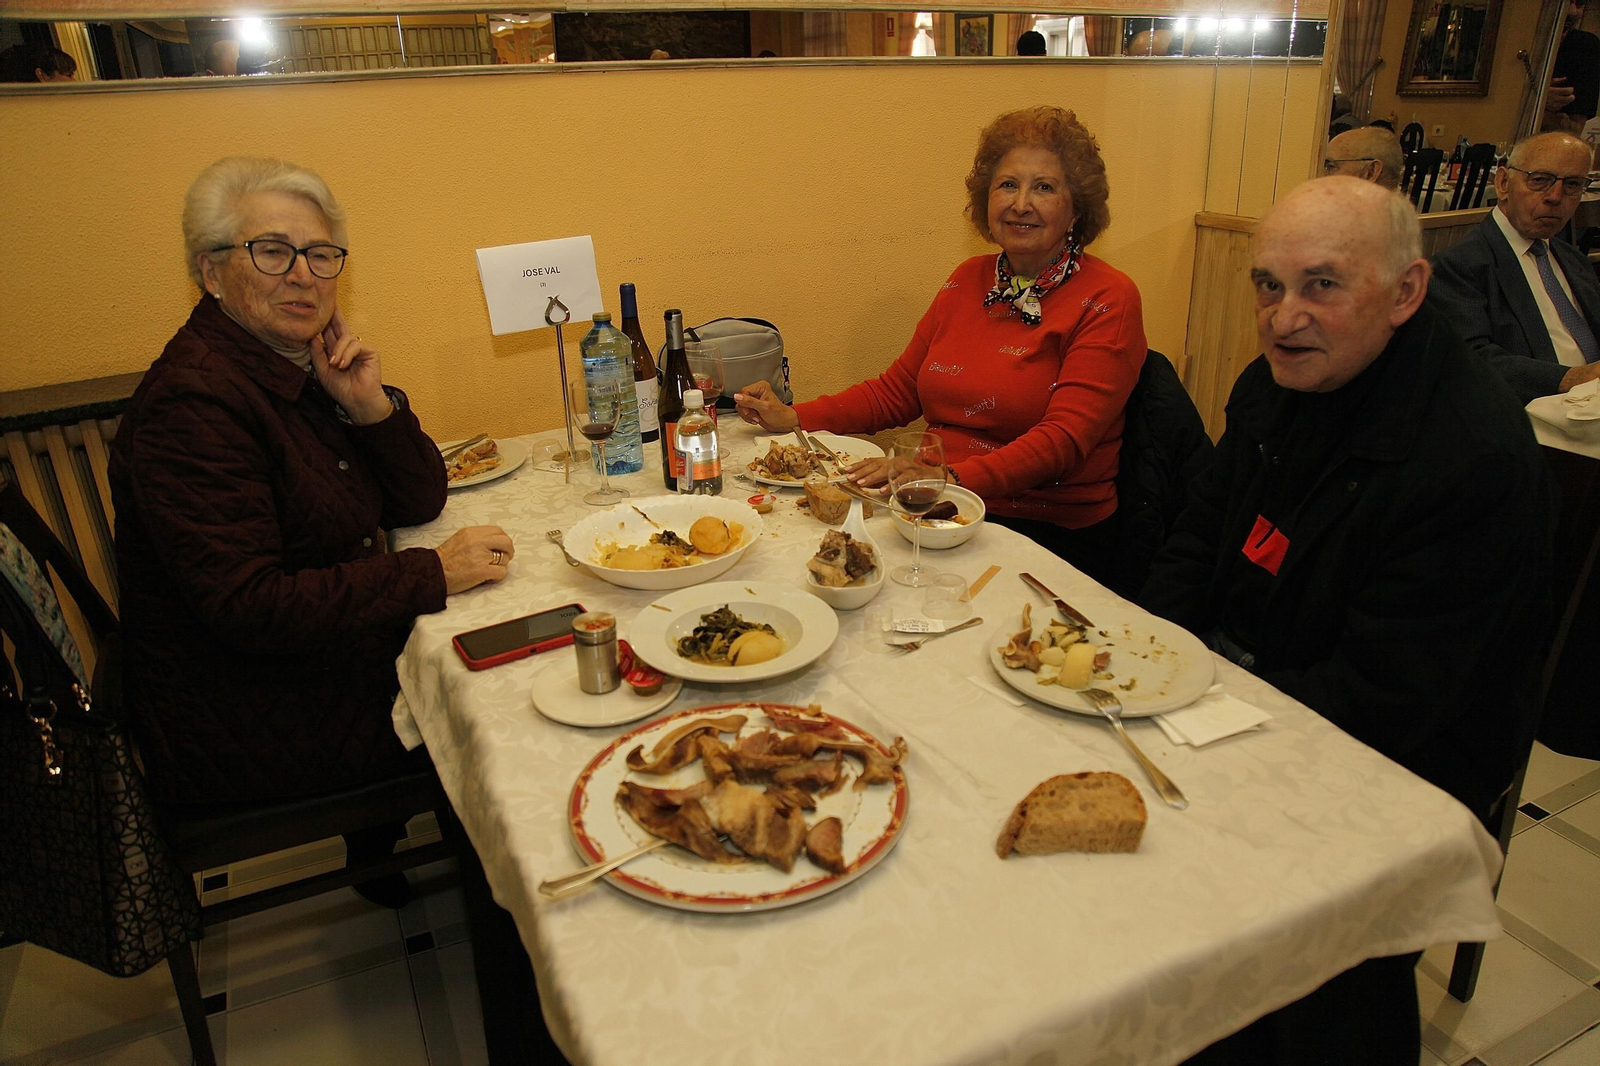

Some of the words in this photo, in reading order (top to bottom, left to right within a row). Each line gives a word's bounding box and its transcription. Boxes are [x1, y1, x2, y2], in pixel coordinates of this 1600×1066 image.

[522, 268, 543, 278] JOSE
[544, 266, 561, 275] VAL
[963, 396, 995, 418] Beauty
